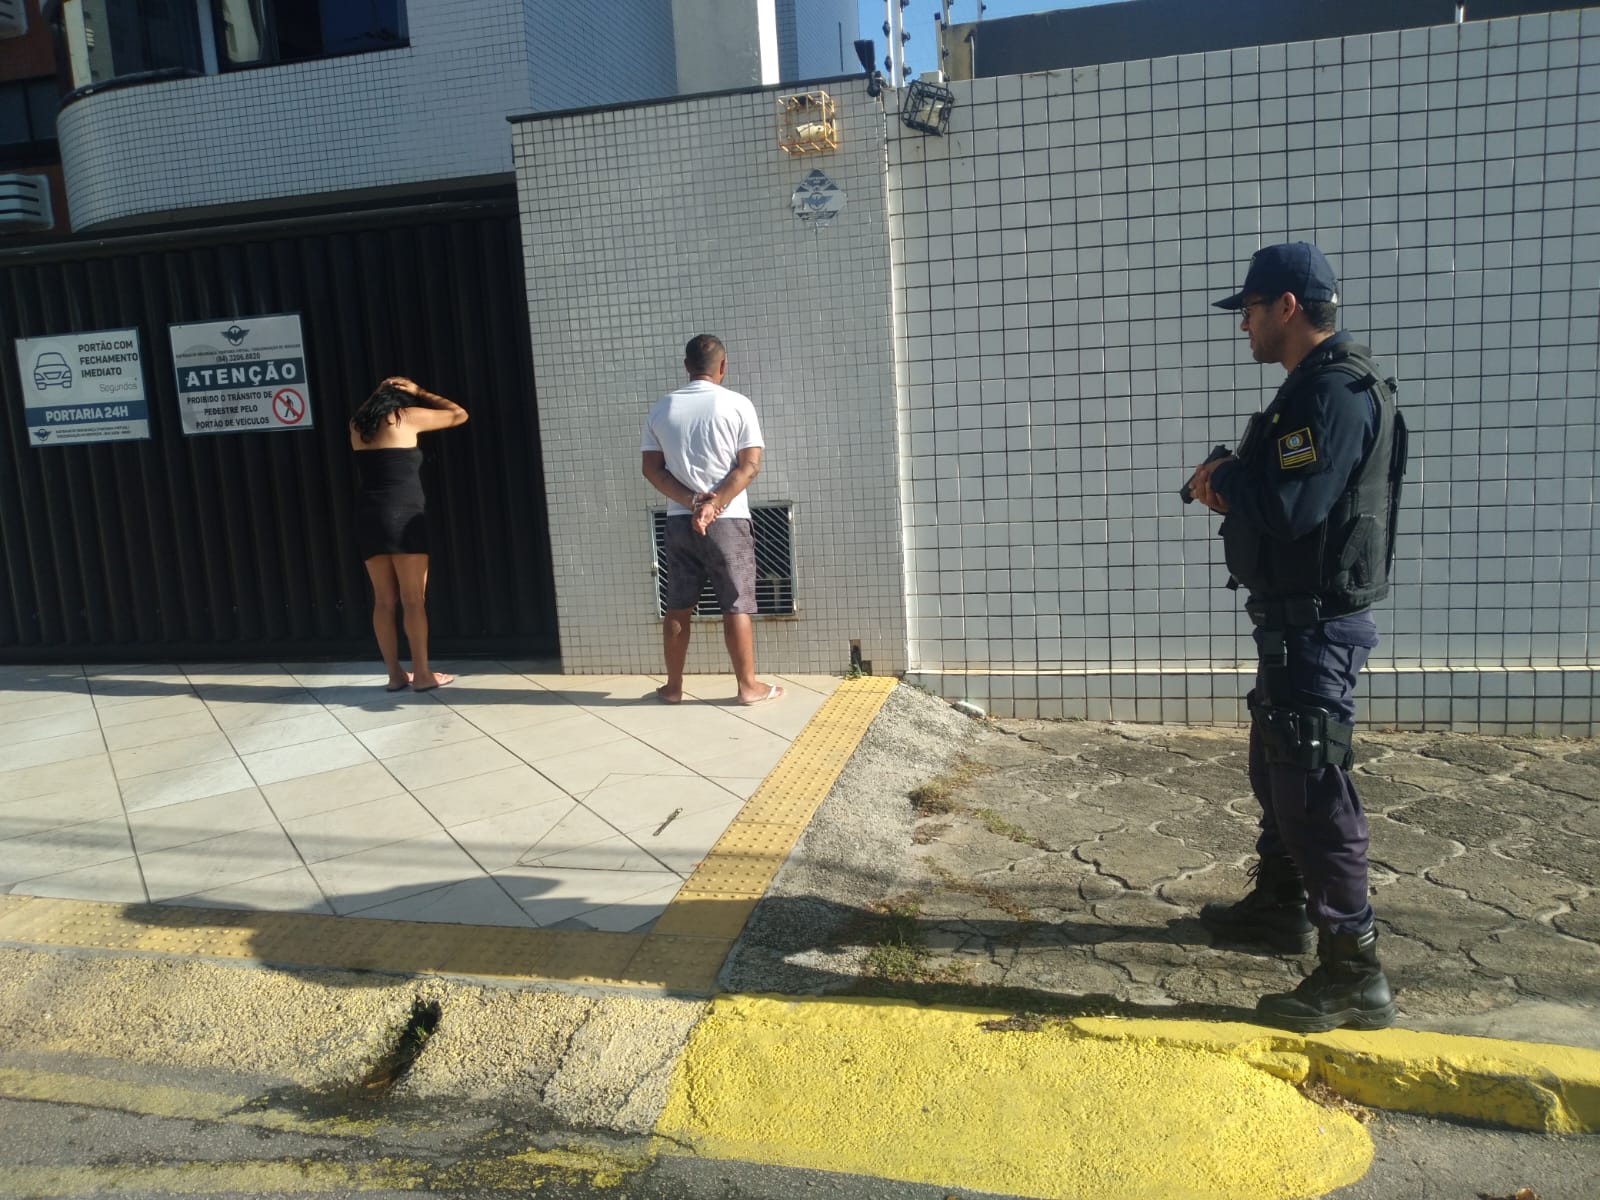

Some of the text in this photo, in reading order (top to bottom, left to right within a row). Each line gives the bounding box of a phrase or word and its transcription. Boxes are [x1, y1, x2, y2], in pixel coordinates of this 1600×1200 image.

[78, 340, 134, 353] PORTÃO COM
[80, 352, 138, 366] FECHAMENTO
[81, 367, 122, 378] IMEDIATO
[187, 361, 296, 387] ATENÇÃO
[187, 390, 273, 405] PROIBIDO O TRÂNSITO DE
[45, 405, 129, 423] PORTARIA 24H
[204, 405, 258, 416] PEDESTRE PELO
[195, 416, 270, 429] PORTÃO DE VEÍCULOS
